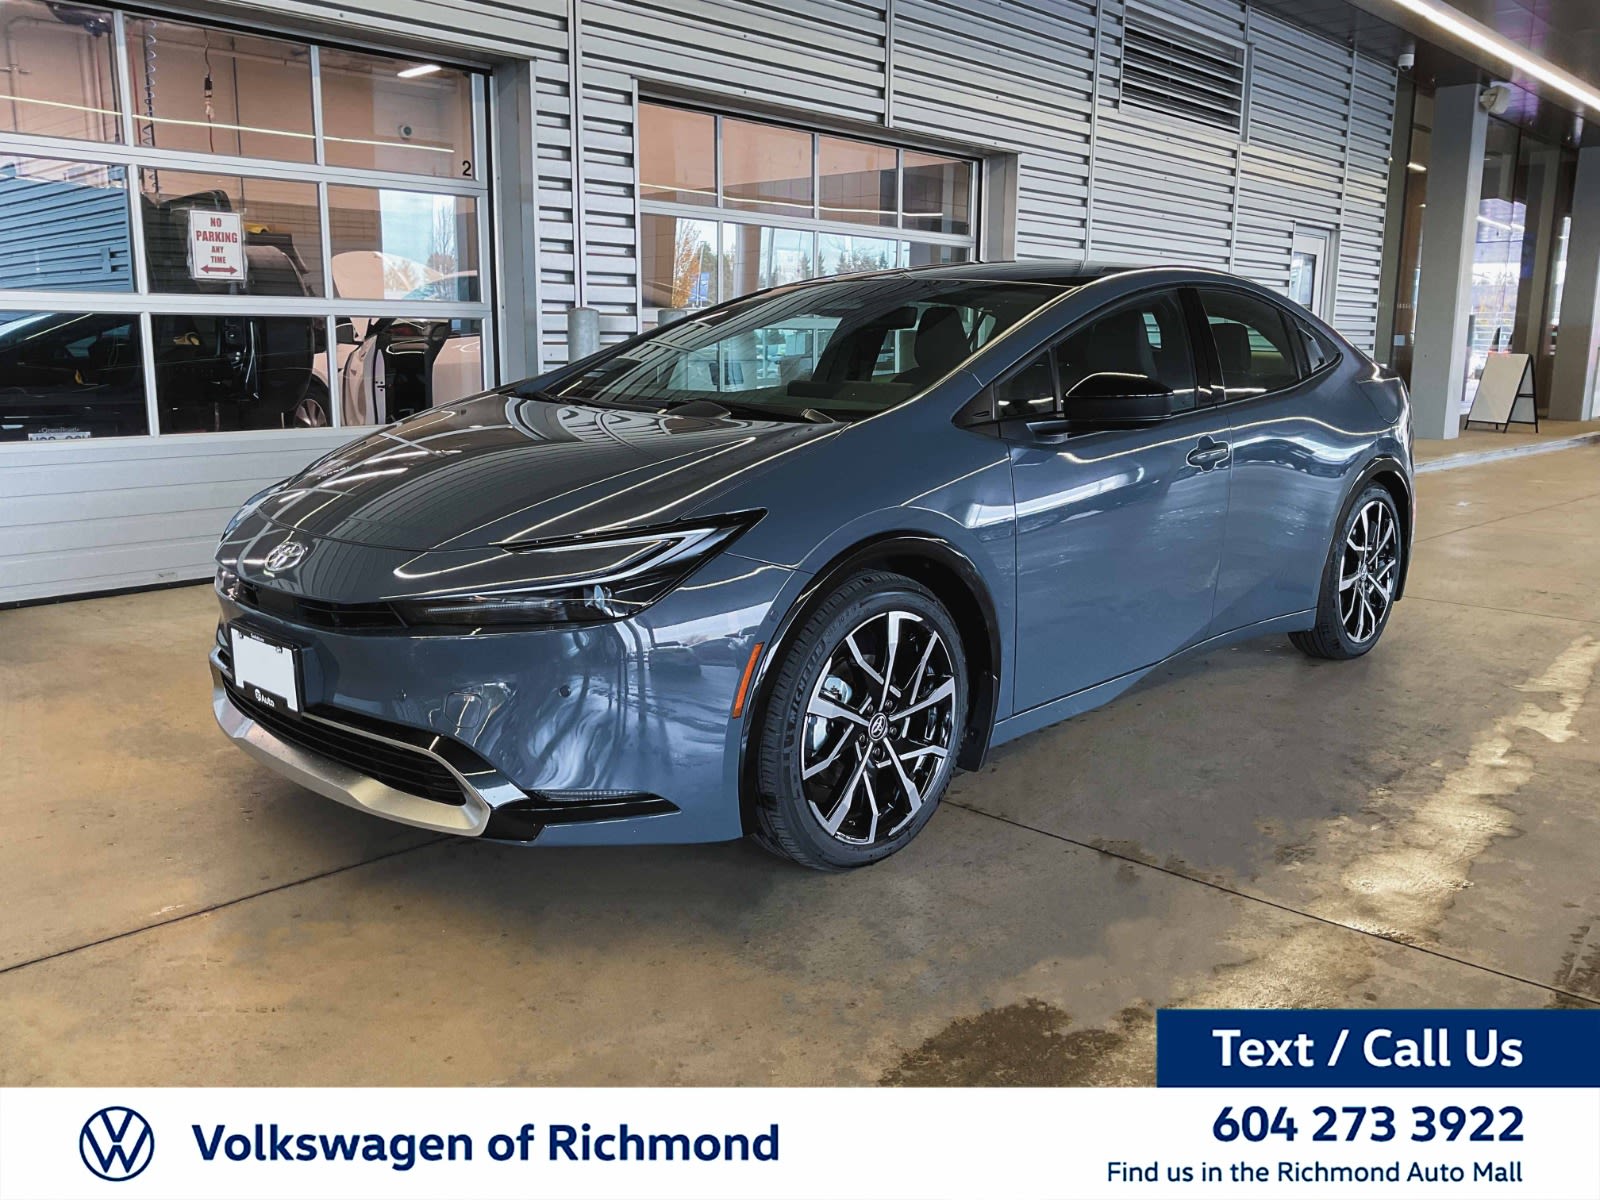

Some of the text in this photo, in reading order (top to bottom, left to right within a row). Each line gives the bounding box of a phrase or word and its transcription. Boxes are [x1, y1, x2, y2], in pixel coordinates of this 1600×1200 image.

[462, 160, 472, 176] 2
[210, 217, 222, 228] NO
[195, 230, 238, 243] PARKING
[211, 245, 224, 254] ANY
[210, 255, 226, 264] TIME
[790, 644, 826, 723] MICHELIN
